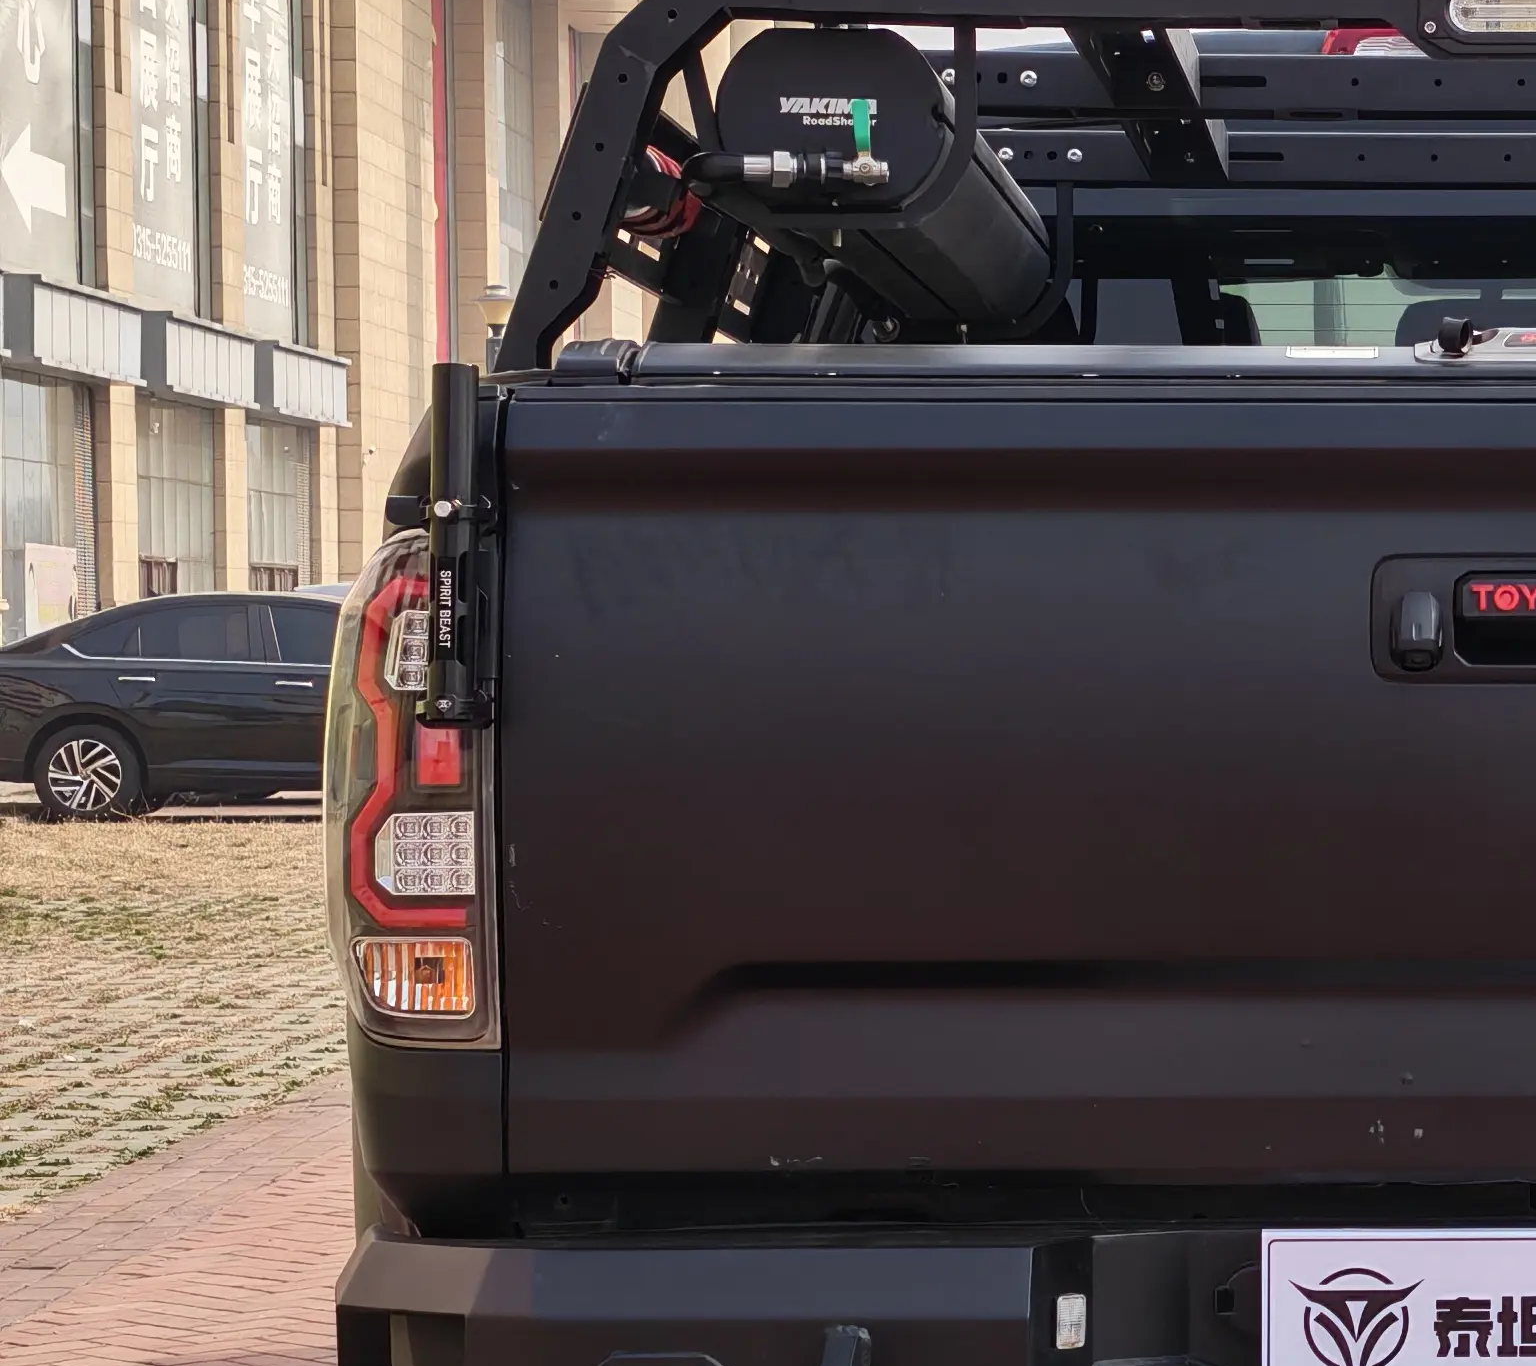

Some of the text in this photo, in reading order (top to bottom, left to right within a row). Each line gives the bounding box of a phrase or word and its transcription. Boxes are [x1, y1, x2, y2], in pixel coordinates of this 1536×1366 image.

[802, 116, 877, 127] RoadShor
[243, 263, 289, 307] 315-5255111
[438, 570, 452, 649] SPIRIT BEAST
